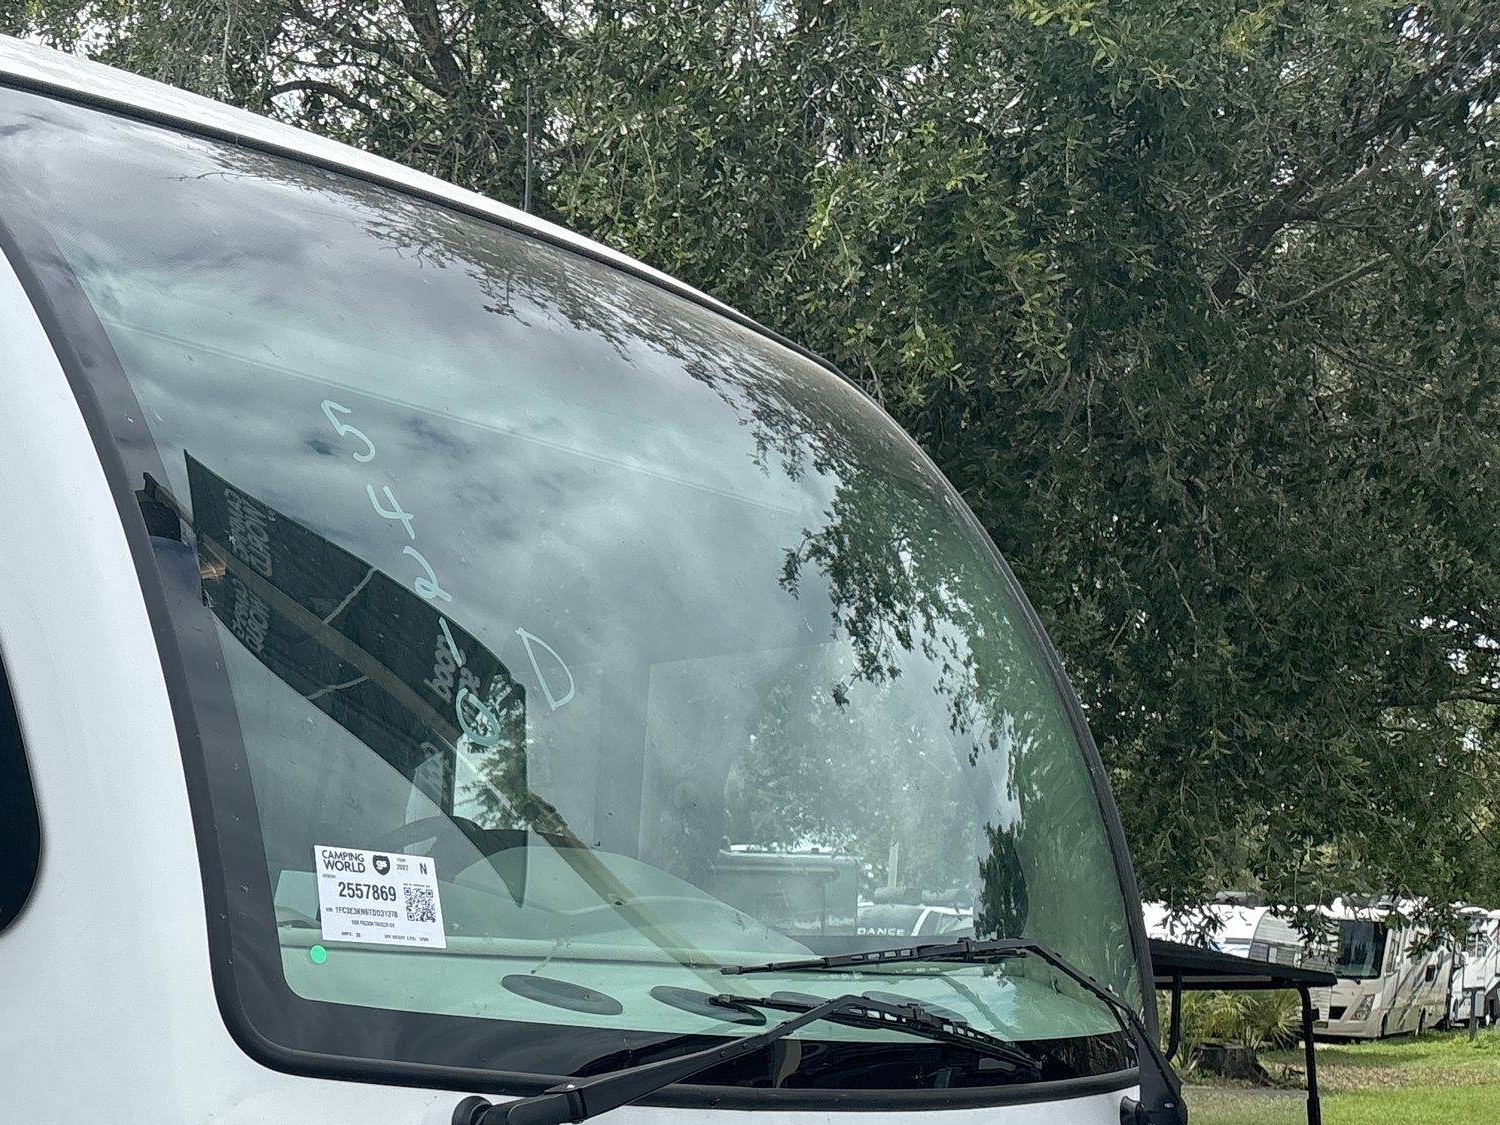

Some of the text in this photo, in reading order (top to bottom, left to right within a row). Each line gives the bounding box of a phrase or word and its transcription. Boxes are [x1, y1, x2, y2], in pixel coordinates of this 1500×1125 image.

[322, 849, 365, 862] CAMPING
[323, 859, 366, 873] WORLD
[419, 862, 428, 875] N
[338, 881, 397, 902] 2557869
